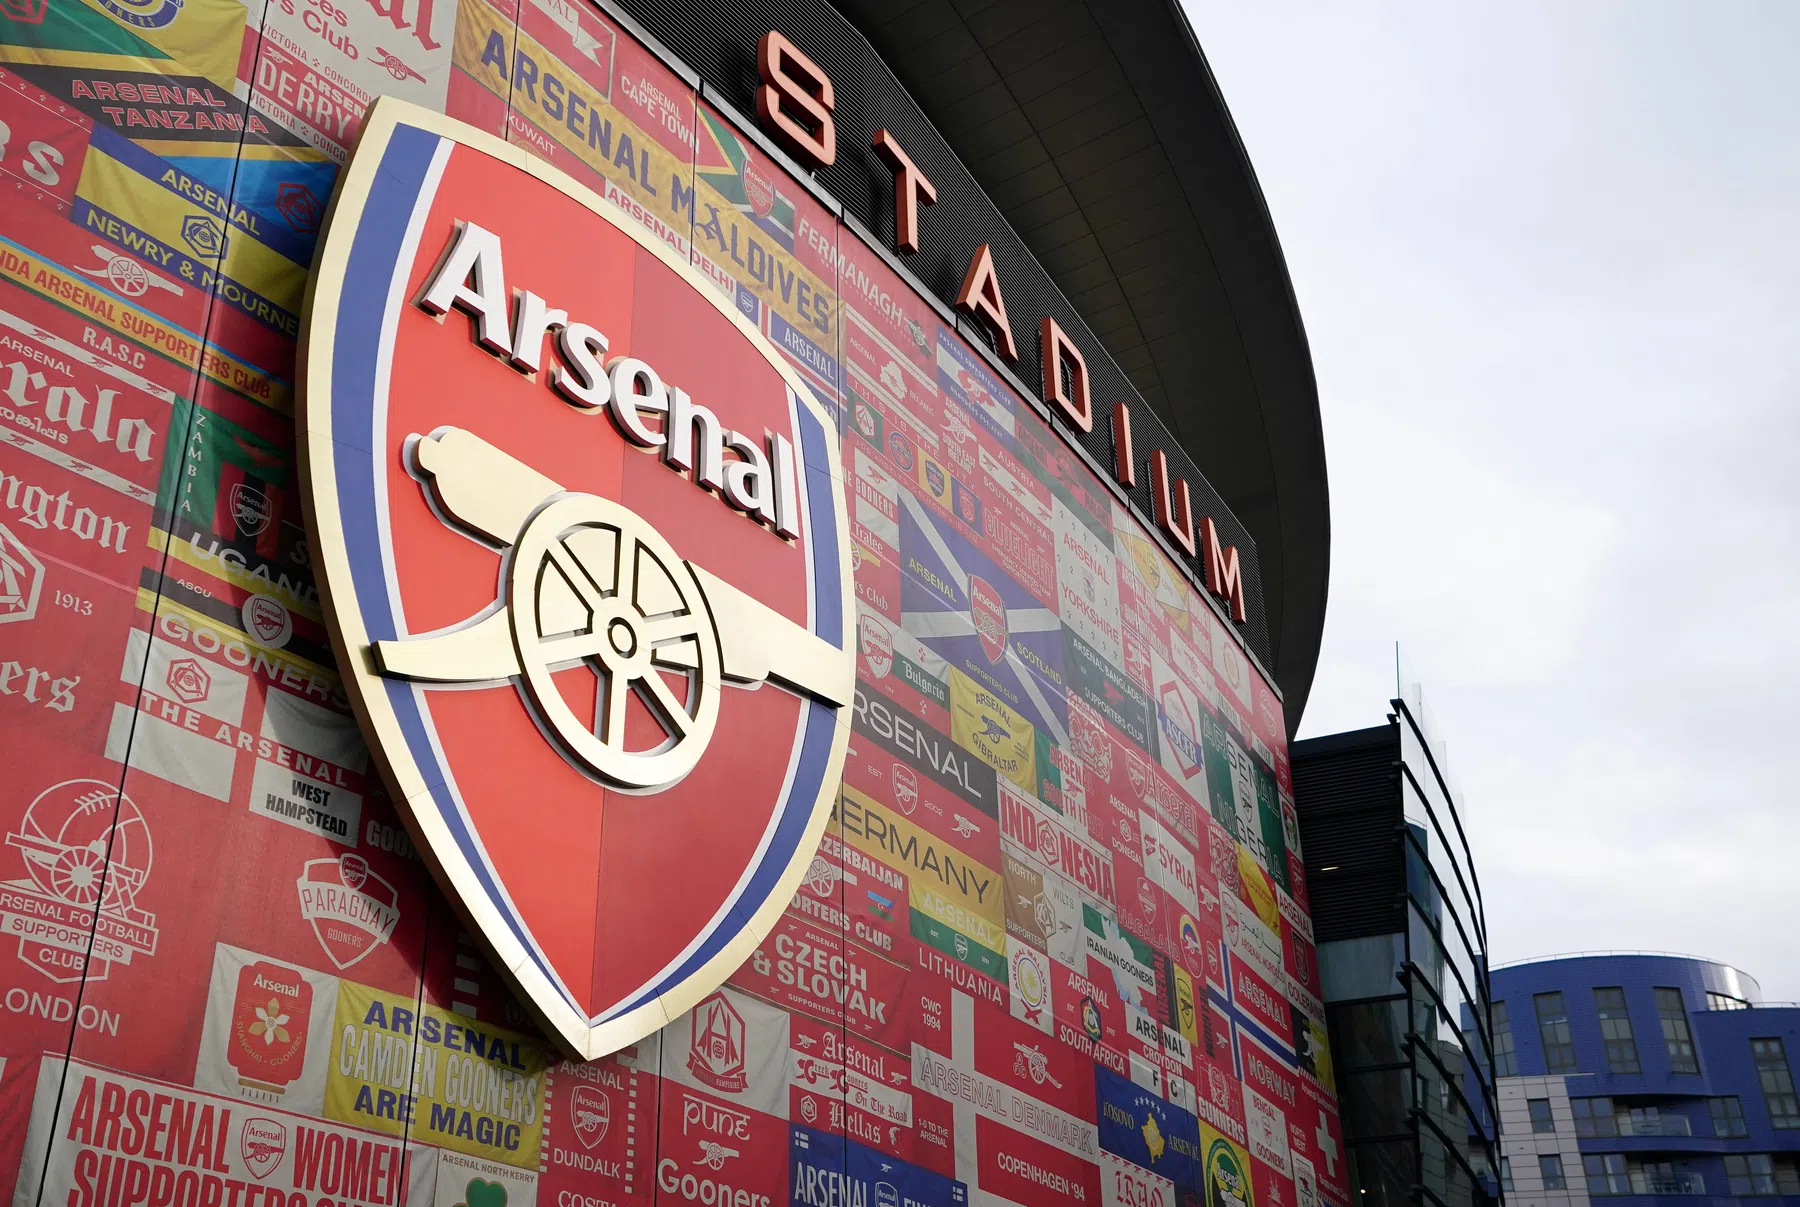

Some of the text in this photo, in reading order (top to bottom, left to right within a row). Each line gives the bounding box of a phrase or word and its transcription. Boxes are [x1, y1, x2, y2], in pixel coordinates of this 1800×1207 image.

[259, 20, 307, 62] VICTORIA
[302, 9, 359, 60] Club
[72, 79, 226, 107] ARSENAL
[250, 93, 296, 130] VICTORIA
[258, 56, 352, 139] DERRY
[640, 78, 682, 120] ARSENAL
[102, 107, 268, 133] TANZANIA
[506, 111, 556, 156] KUWAIT
[620, 75, 700, 154] CAPE TOWN
[481, 28, 829, 334] ARSENAL MALDIVES
[745, 166, 774, 192] Arsenal
[161, 169, 260, 236] ARSENAL
[608, 188, 734, 293] ARSENAL DELHI
[87, 209, 297, 337] NEWRY & MOURNE
[798, 218, 903, 327] FERMANAGH
[33, 269, 271, 400] ARSENAL SUPPORTERS CLUB
[757, 30, 1246, 623] STADIUM
[0, 336, 75, 378] ARSENAL
[82, 326, 146, 370] R.A.S.C
[784, 328, 834, 380] ARSENAL
[850, 337, 877, 366] ARSENAL
[420, 220, 799, 540] Arsenal
[939, 333, 1011, 406] ARSENAL SUPPORTERS CLUB
[909, 391, 935, 417] BELARUS
[945, 397, 971, 427] ARSENAL
[853, 380, 886, 413] THIS
[895, 415, 907, 432] IS
[916, 435, 940, 461] THE
[948, 463, 976, 490] CITY
[943, 432, 976, 468] SOUTH EAST
[181, 413, 207, 512] ZAMBIA
[948, 446, 972, 474] IRELAND
[998, 451, 1035, 490] AUSTRIA
[237, 490, 268, 512] Arsenal
[855, 477, 894, 519] GOONERS
[983, 476, 1013, 509] SOUTH
[1015, 506, 1053, 545] CENTRAL
[854, 521, 884, 554] Tralee
[984, 508, 1054, 590] BLUELIGHT
[1010, 521, 1030, 541] ARSENAL
[1063, 532, 1110, 585] ARSENAL
[177, 578, 212, 598] ASCU
[866, 586, 888, 611] Club
[909, 558, 957, 602] ARSENAL
[54, 590, 94, 616] 1913
[256, 604, 284, 620] Arsenal
[973, 586, 1003, 619] Arsenal
[1061, 581, 1120, 646] YORKSHIRE
[864, 625, 889, 648] Arsenal
[160, 612, 352, 709] GOONERS
[965, 659, 1019, 704] SUPPORTERS CLUB
[1017, 643, 1061, 685] SCOTLAND
[1073, 639, 1104, 673] ARSENAL
[1105, 665, 1149, 711] BANGLADESH
[905, 662, 945, 702] Bulgaria
[976, 693, 1011, 729] ARSENAL
[1084, 687, 1127, 729] SUPPORTERS
[1127, 724, 1144, 744] CLUB
[141, 691, 349, 788] THE ARSENAL
[972, 733, 1018, 772] GIBRALTAR
[1050, 743, 1095, 796] ARSENAL
[291, 779, 331, 807] WEST
[868, 765, 943, 817] EST. 2002
[1109, 794, 1137, 822] ARSENAL
[265, 793, 348, 837] HAMPSTEAD
[830, 795, 990, 905] ERMANY
[1112, 837, 1144, 867] DONEGAL
[1160, 844, 1196, 896] SYRIA
[1008, 859, 1036, 886] NORTH
[302, 888, 394, 934] PARAGUAY
[923, 893, 995, 947] ARSENAL
[1052, 888, 1075, 910] WILTS
[1279, 895, 1313, 938] ARSENAL
[11, 918, 124, 959] SUPPORTERS
[69, 910, 152, 947] FOOTBALL
[327, 927, 363, 948] GOONERS
[805, 931, 839, 950] ARSENAL
[1006, 918, 1047, 950] SUPPORTERS
[1117, 904, 1181, 962] NAGALAND
[38, 948, 85, 971] CLUB
[775, 933, 867, 991] CZECH
[919, 947, 1003, 1006] LITHUANIA
[1060, 951, 1075, 967] CLUB
[1087, 936, 1154, 987] IRANIAN GOONERS
[253, 973, 299, 998] Arsenal
[753, 950, 886, 1025] & SLOVAK
[921, 996, 942, 1015] CWC
[1067, 972, 1109, 1009] ARSENAL
[1239, 972, 1288, 1032] ARSENAL
[788, 993, 857, 1025] SUPPORTERS CLUB
[923, 1013, 941, 1030] 1994
[236, 1021, 302, 1067] SHANGHAI GOONERS
[363, 1000, 526, 1071] ARSENAL
[822, 1032, 885, 1080] Arsenal
[1059, 1024, 1125, 1075] SOUTH AFRICA
[1136, 1016, 1190, 1058] ARSENAL
[339, 1024, 537, 1126] CAMDEN GOONERS
[560, 1060, 624, 1091] ARSENAL
[1143, 1045, 1183, 1077] CROYDON
[1247, 1052, 1296, 1107] NORWAY
[353, 1085, 521, 1151] ARE MAGIC
[577, 1095, 605, 1111] Arsenal
[828, 1101, 881, 1145] Hellas
[855, 1092, 908, 1123] On The Road
[921, 1057, 1006, 1116] ARSENAL
[1011, 1096, 1092, 1155] DENMARK
[1198, 1096, 1245, 1145] GUNNERS
[1252, 1095, 1276, 1122] BENGAL
[66, 1075, 412, 1207] ARSENAL WOMEN
[249, 1126, 281, 1142] Arsenal
[920, 1130, 947, 1148] ARSENAL
[928, 1121, 949, 1138] TO THE
[1103, 1101, 1200, 1161] KOSOVO ARSENAL
[442, 1154, 535, 1183] ARSENAL NORTH KERRY
[554, 1148, 620, 1179] DUNDALK
[997, 1152, 1070, 1196] COPENHAGEN
[1216, 1161, 1241, 1189] Arsenal
[1256, 1143, 1285, 1171] GOONERS
